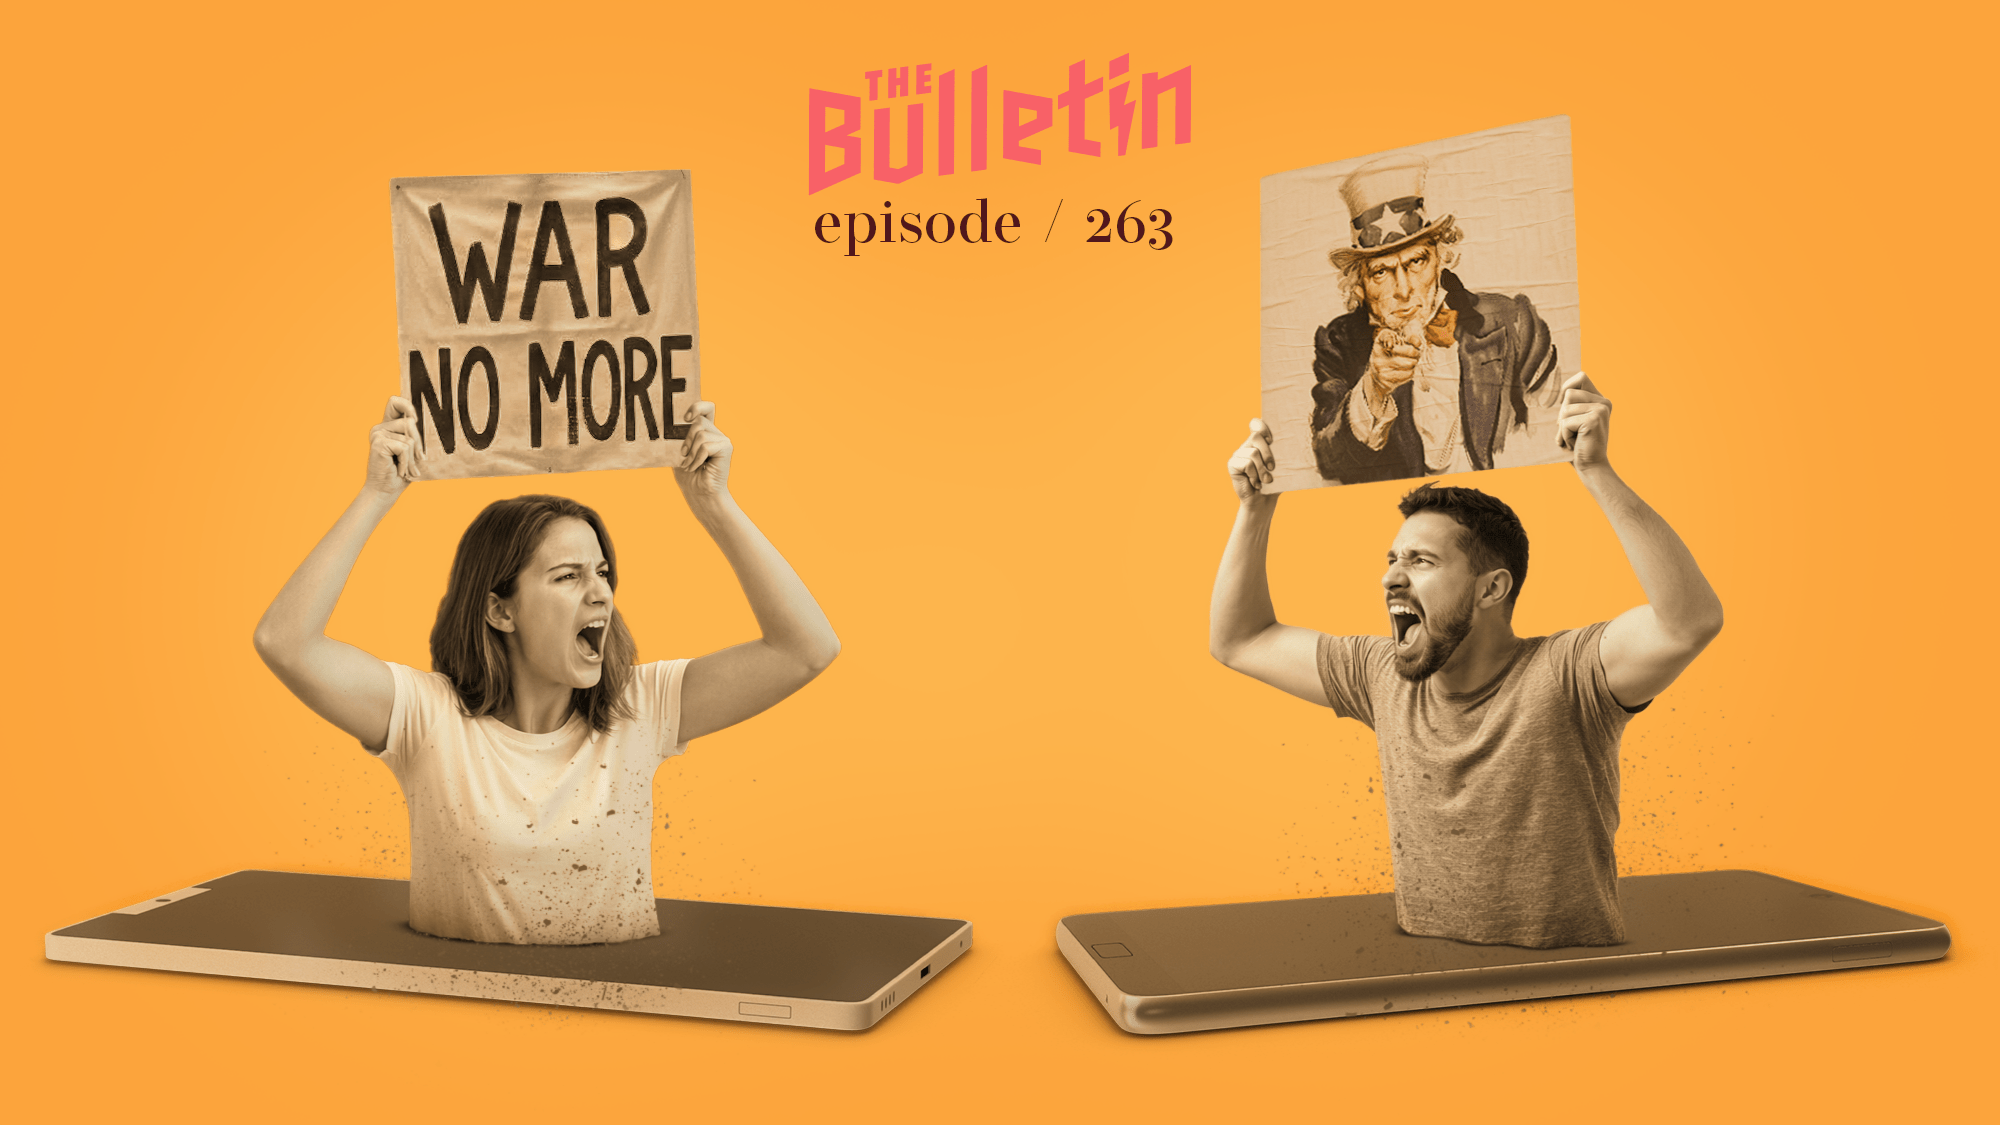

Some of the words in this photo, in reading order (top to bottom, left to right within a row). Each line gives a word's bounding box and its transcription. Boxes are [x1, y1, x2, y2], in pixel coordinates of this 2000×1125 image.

[428, 197, 651, 324] WAR
[409, 346, 500, 455] NO
[528, 334, 693, 449] MORE
